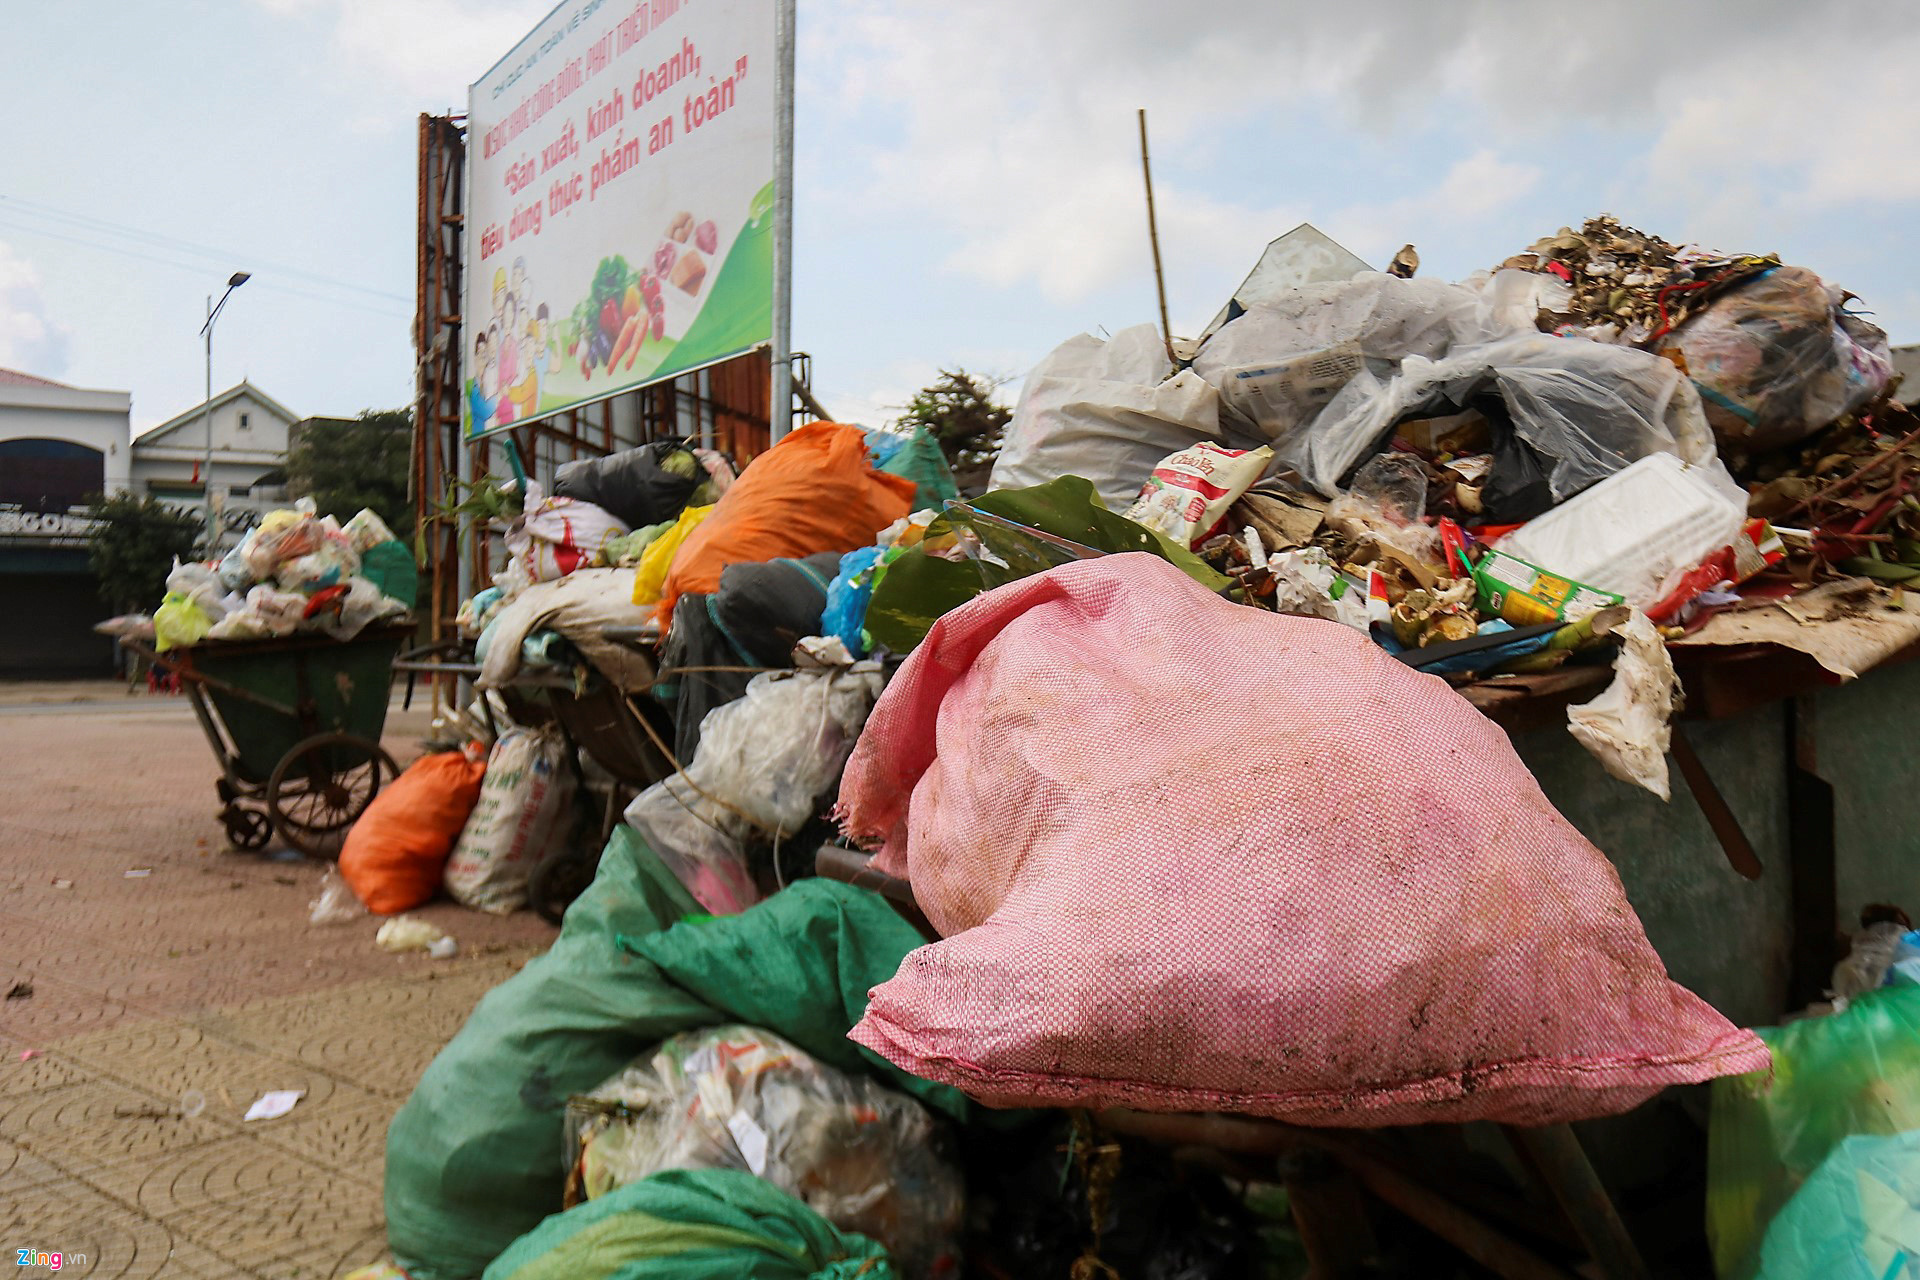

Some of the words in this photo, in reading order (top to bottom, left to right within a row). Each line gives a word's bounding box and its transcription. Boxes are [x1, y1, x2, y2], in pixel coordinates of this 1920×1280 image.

[586, 87, 624, 143] kinh
[632, 36, 702, 111] doanh,
[508, 200, 543, 242] dùng
[549, 171, 584, 217] thực
[590, 127, 640, 202] phẩm
[648, 114, 673, 156] an
